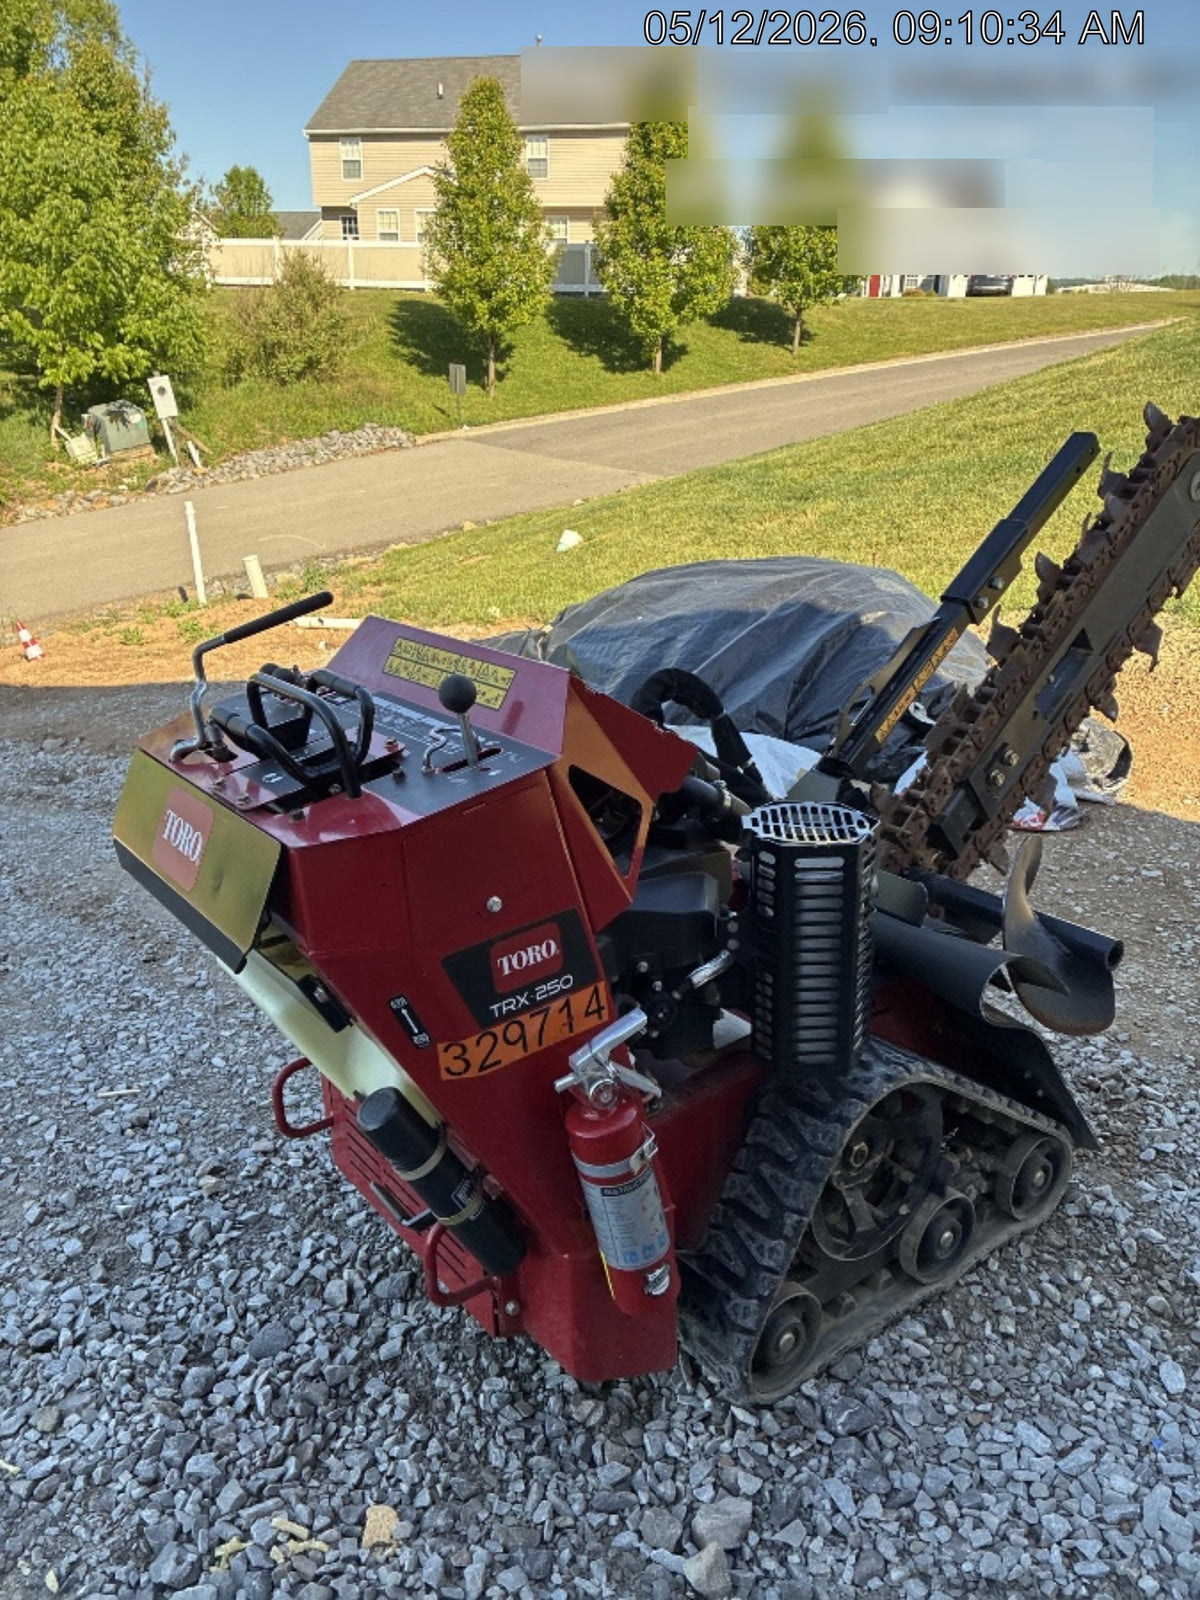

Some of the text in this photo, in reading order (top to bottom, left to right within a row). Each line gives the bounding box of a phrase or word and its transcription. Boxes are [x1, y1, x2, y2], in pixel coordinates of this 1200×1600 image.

[162, 809, 203, 861] TORO
[497, 939, 557, 976] TORO
[443, 984, 606, 1076] 329714
